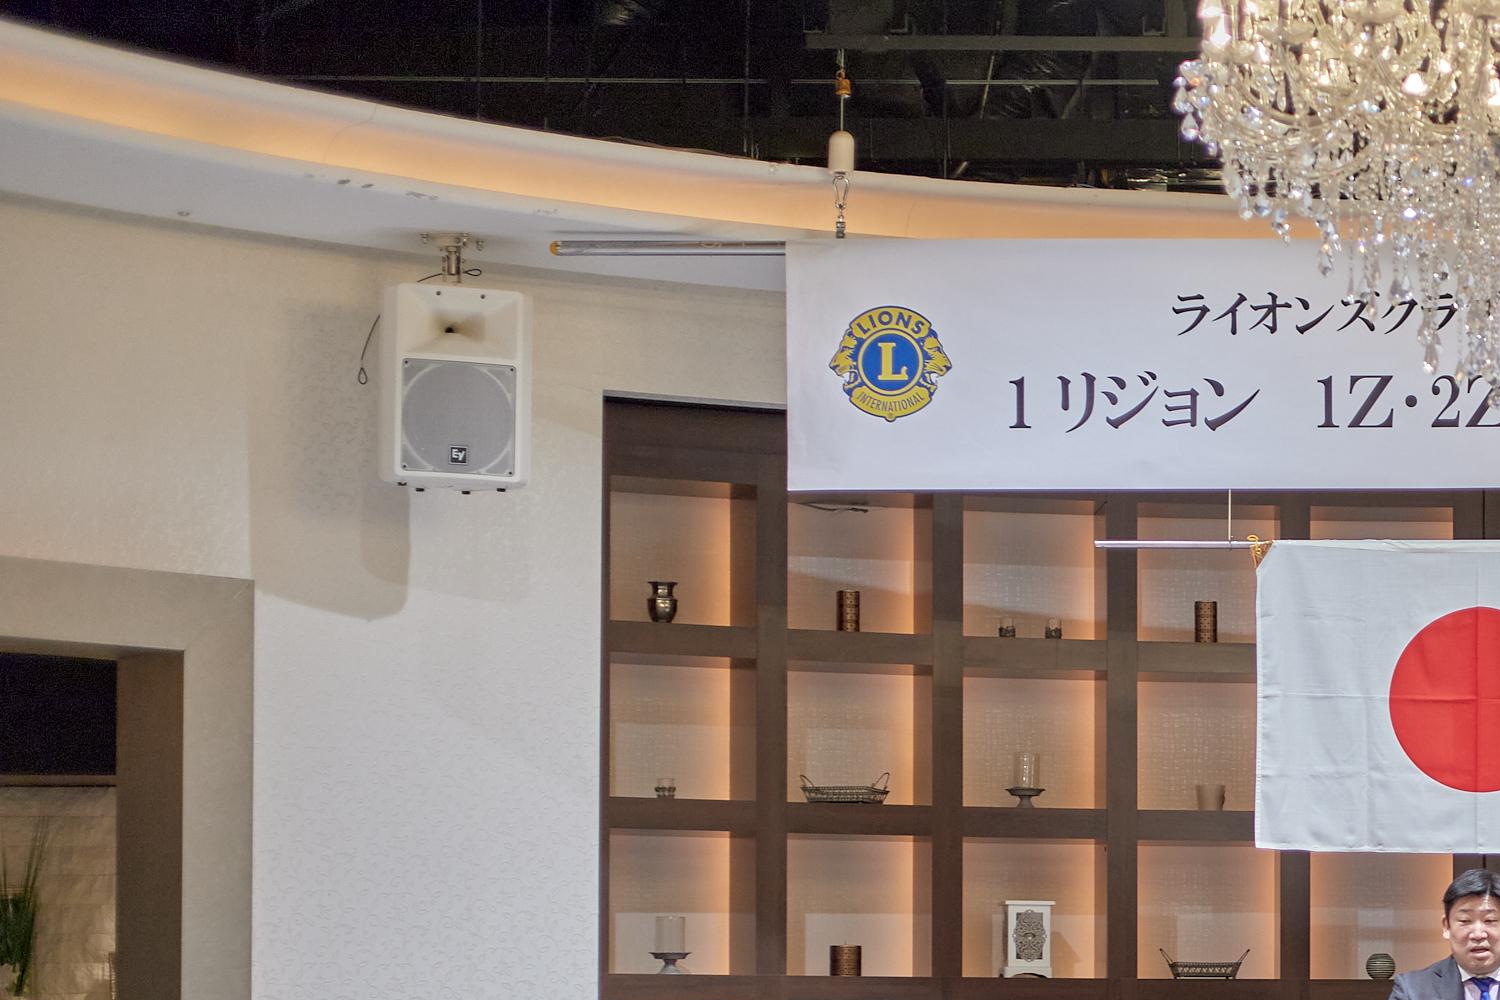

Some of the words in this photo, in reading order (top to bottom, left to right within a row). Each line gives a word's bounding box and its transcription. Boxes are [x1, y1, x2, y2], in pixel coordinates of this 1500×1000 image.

[855, 310, 925, 335] LIONS
[877, 342, 909, 381] L
[856, 391, 926, 413] INTERNATIONAL
[1009, 376, 1033, 430] 1
[1057, 369, 1261, 435] リジョン
[452, 448, 466, 461] EV
